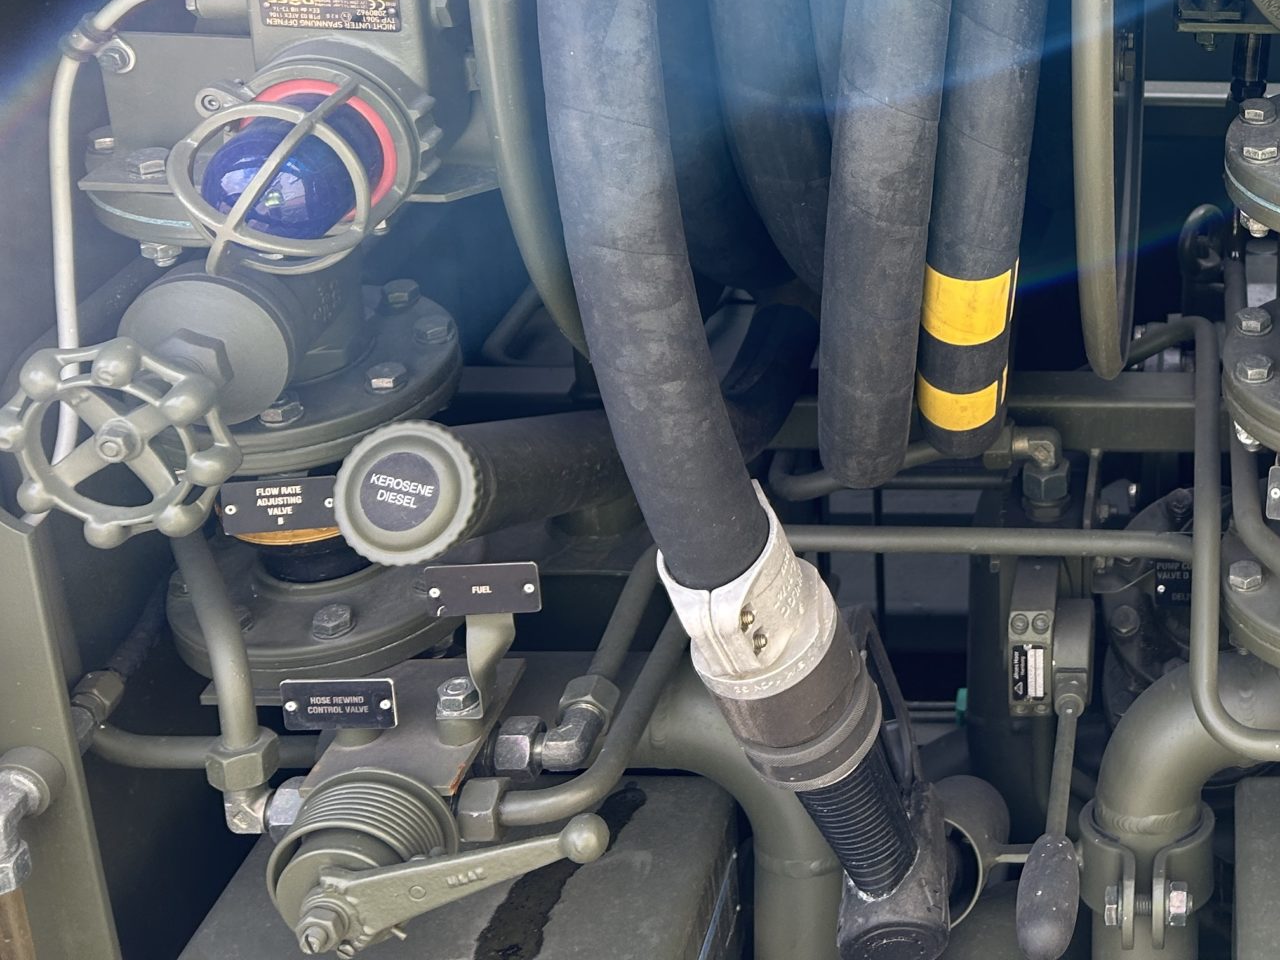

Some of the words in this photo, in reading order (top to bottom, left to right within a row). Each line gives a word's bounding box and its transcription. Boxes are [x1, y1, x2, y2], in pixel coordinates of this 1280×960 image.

[299, 19, 343, 28] SPANNUNG
[344, 20, 371, 29] UNTER
[373, 21, 396, 30] NICHT
[370, 473, 434, 497] KEROSENE
[256, 487, 279, 496] FLOW
[281, 485, 302, 495] RATE
[256, 496, 303, 507] ADJUSTING
[376, 489, 418, 509] DIESEL
[267, 506, 293, 516] VALVE
[471, 585, 492, 594] FUEL
[310, 696, 332, 705] HOSE
[333, 696, 364, 704] REWIND
[307, 706, 343, 714] CONTROL
[345, 705, 369, 713] VALVE
